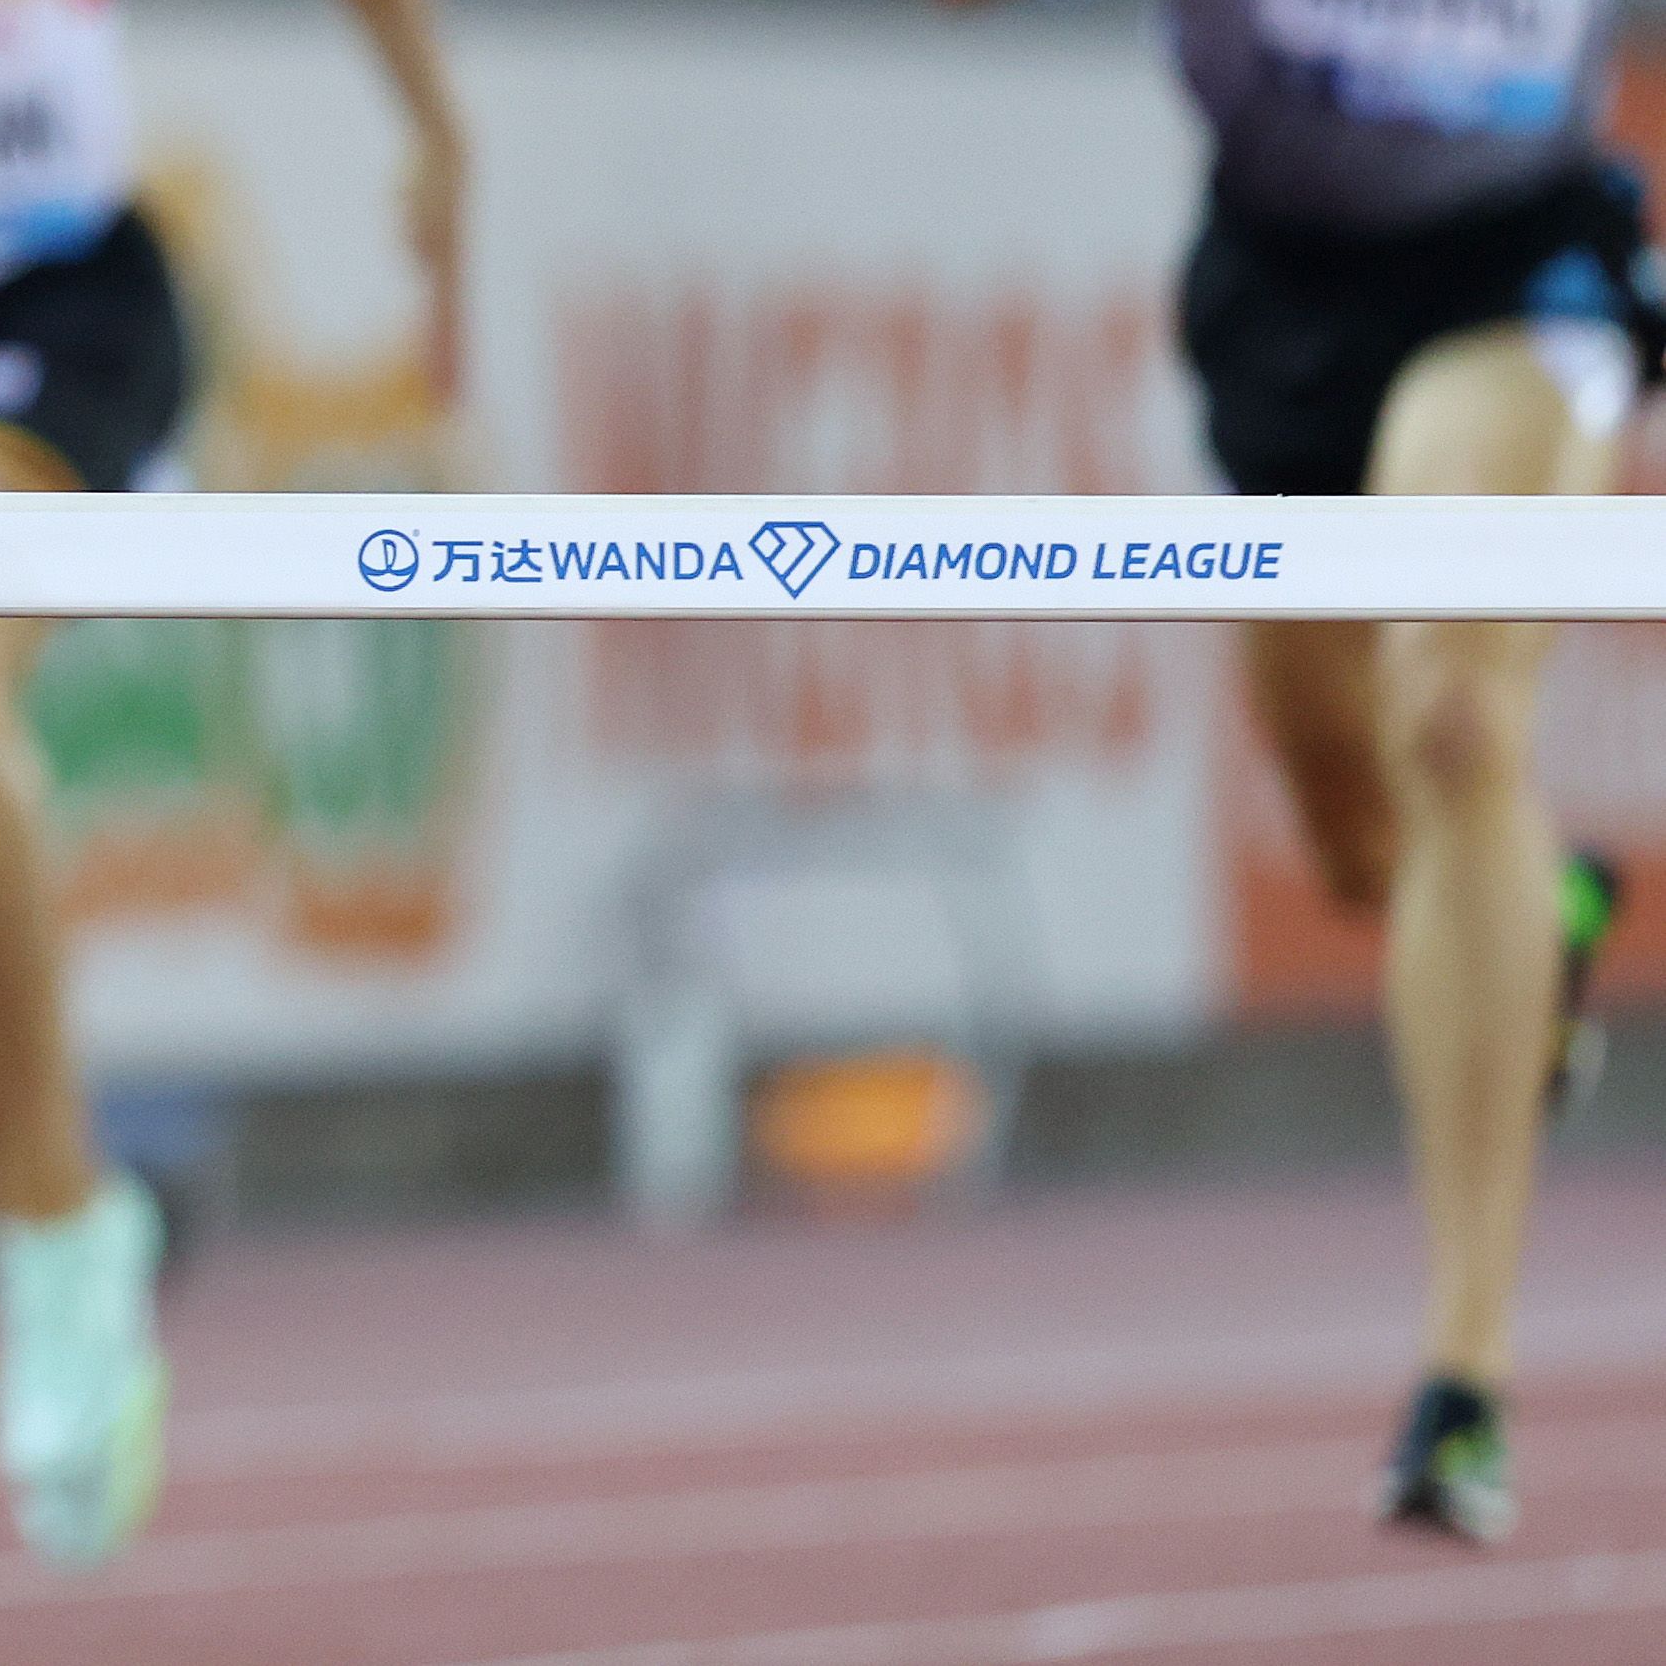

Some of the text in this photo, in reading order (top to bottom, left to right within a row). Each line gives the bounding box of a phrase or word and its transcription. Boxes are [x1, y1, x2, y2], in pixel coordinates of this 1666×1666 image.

[433, 540, 1284, 583] 万达 WANDA DIAMOND LEAGUE
